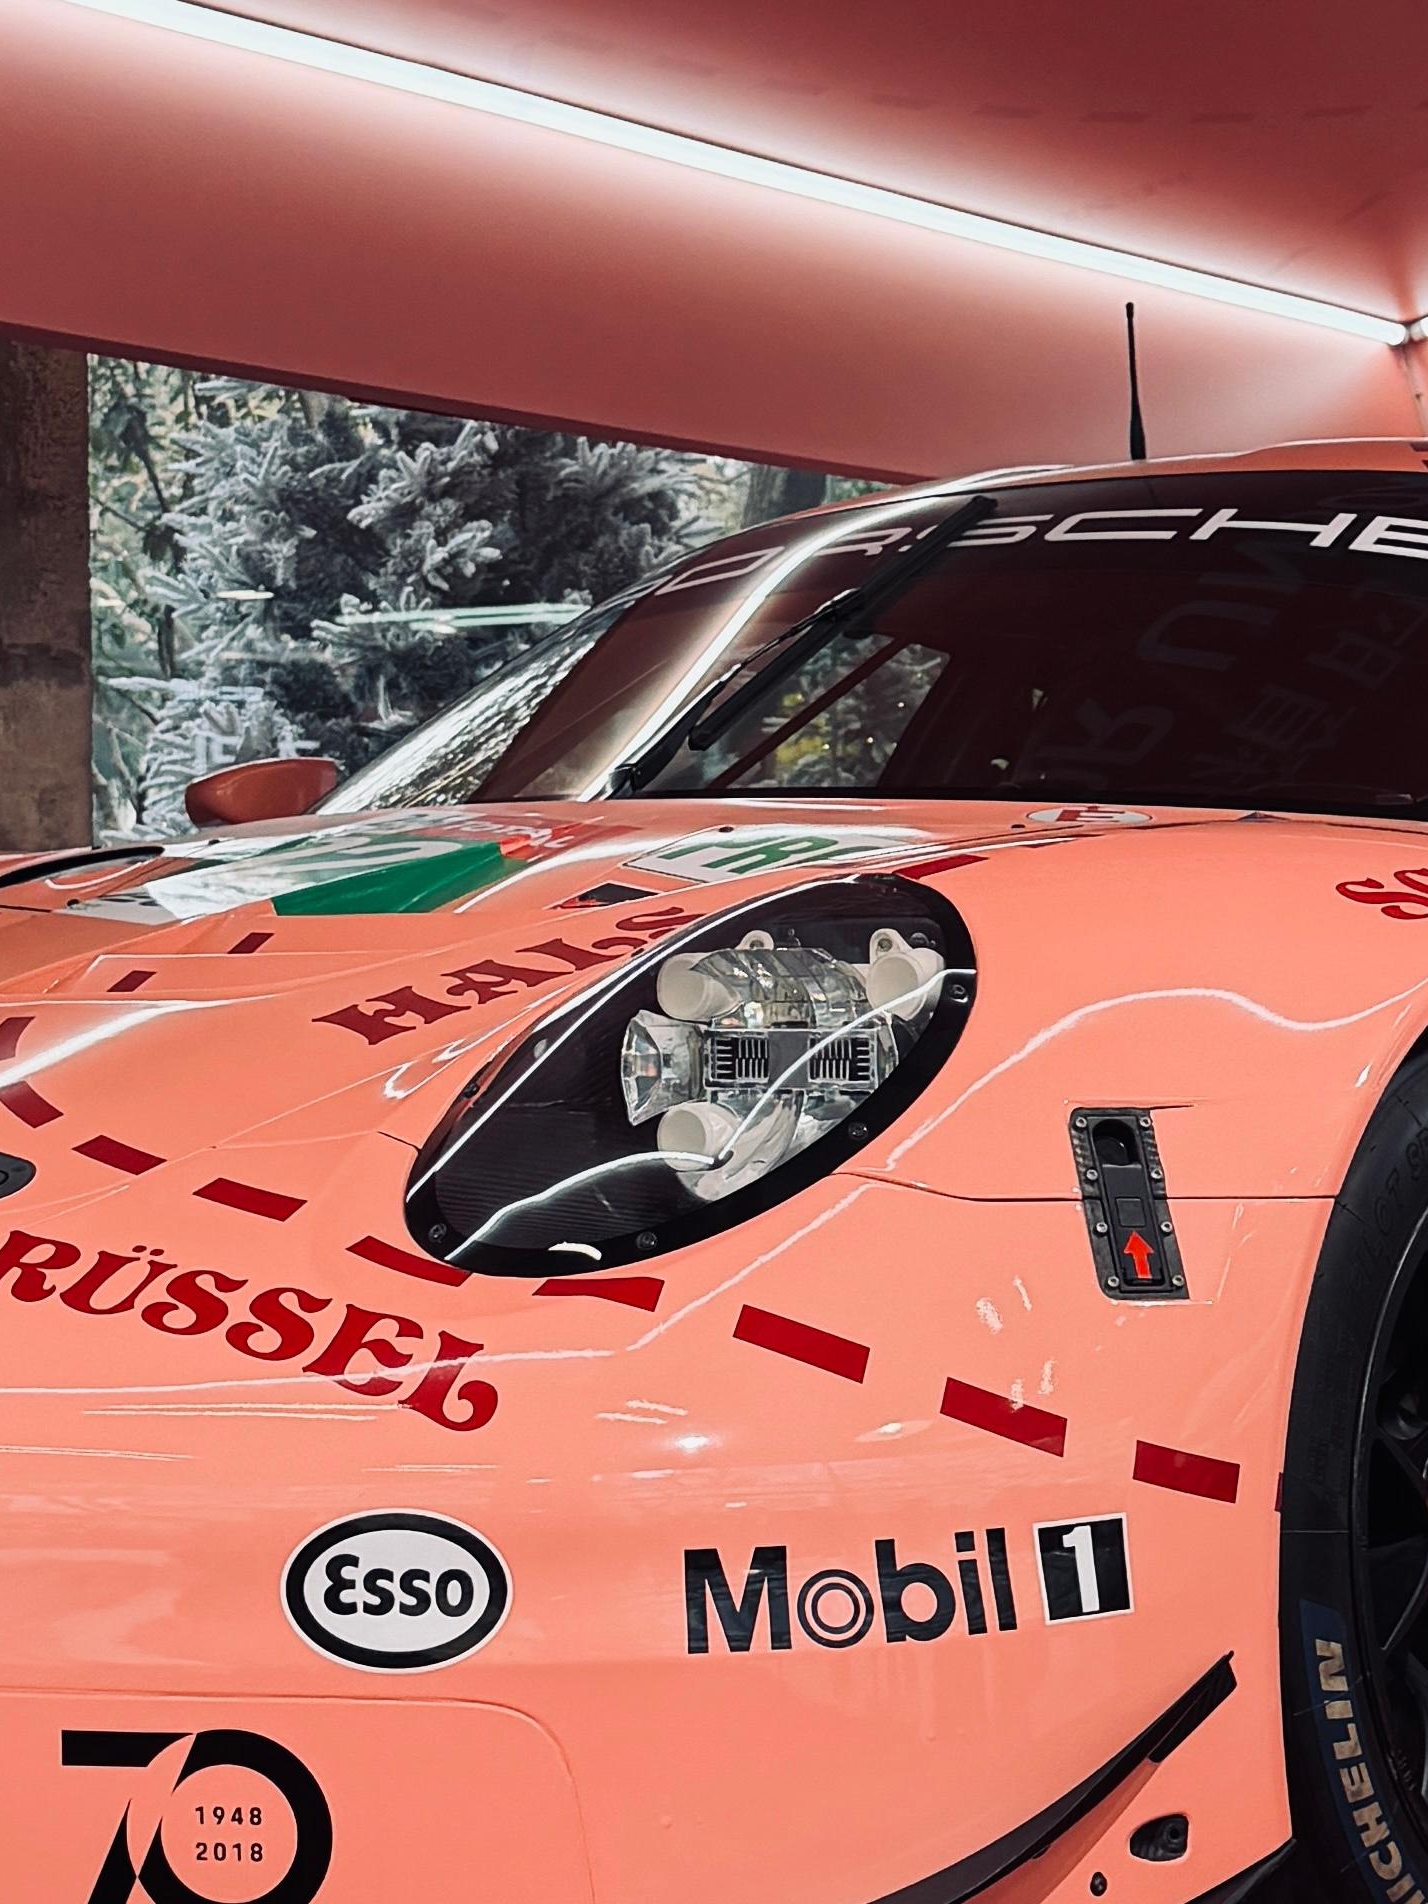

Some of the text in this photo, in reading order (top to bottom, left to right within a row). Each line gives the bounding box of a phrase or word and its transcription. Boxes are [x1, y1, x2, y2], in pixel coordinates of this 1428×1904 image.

[312, 906, 711, 1047] HALS
[324, 1553, 474, 1618] Esso
[683, 1525, 1106, 1655] Mobil 1
[194, 1805, 264, 1826] 1948
[194, 1841, 265, 1863] 2018
